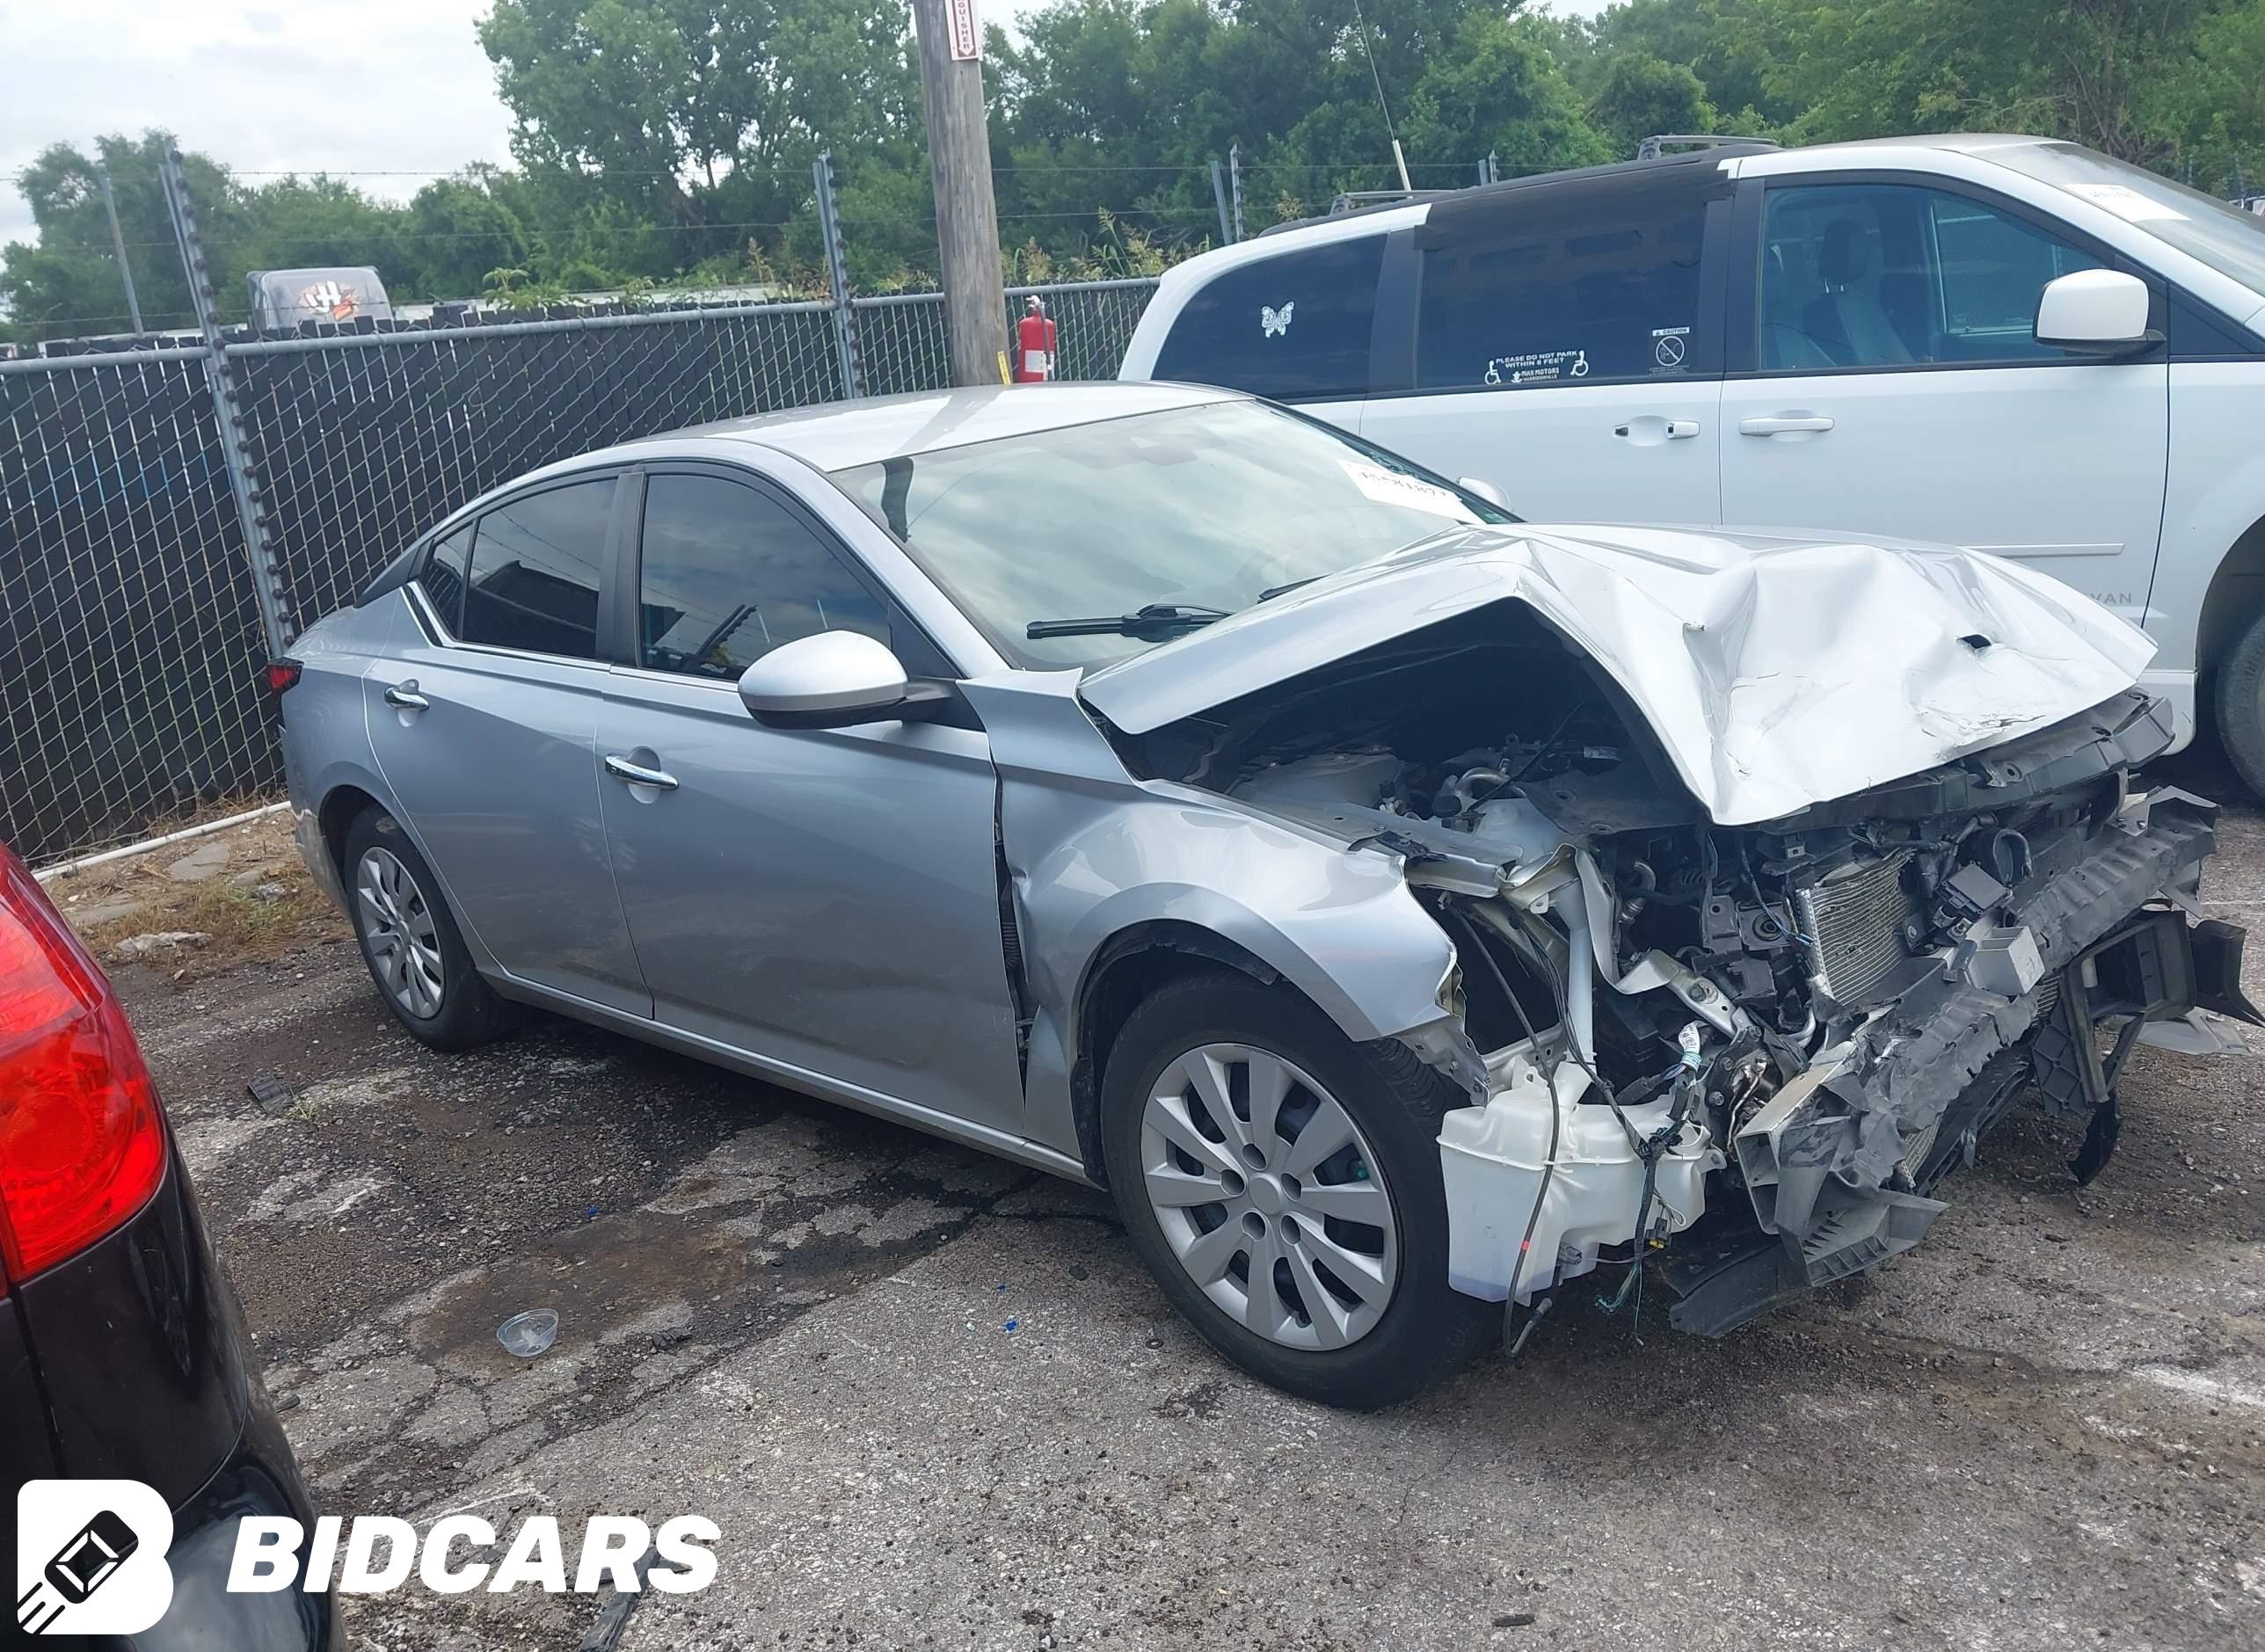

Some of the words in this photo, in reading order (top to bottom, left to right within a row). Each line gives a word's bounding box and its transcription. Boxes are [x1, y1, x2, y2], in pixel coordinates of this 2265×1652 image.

[958, 0, 970, 49] GUISHER
[1496, 355, 1525, 364] PLEASE
[1535, 367, 1559, 375] MOTORS
